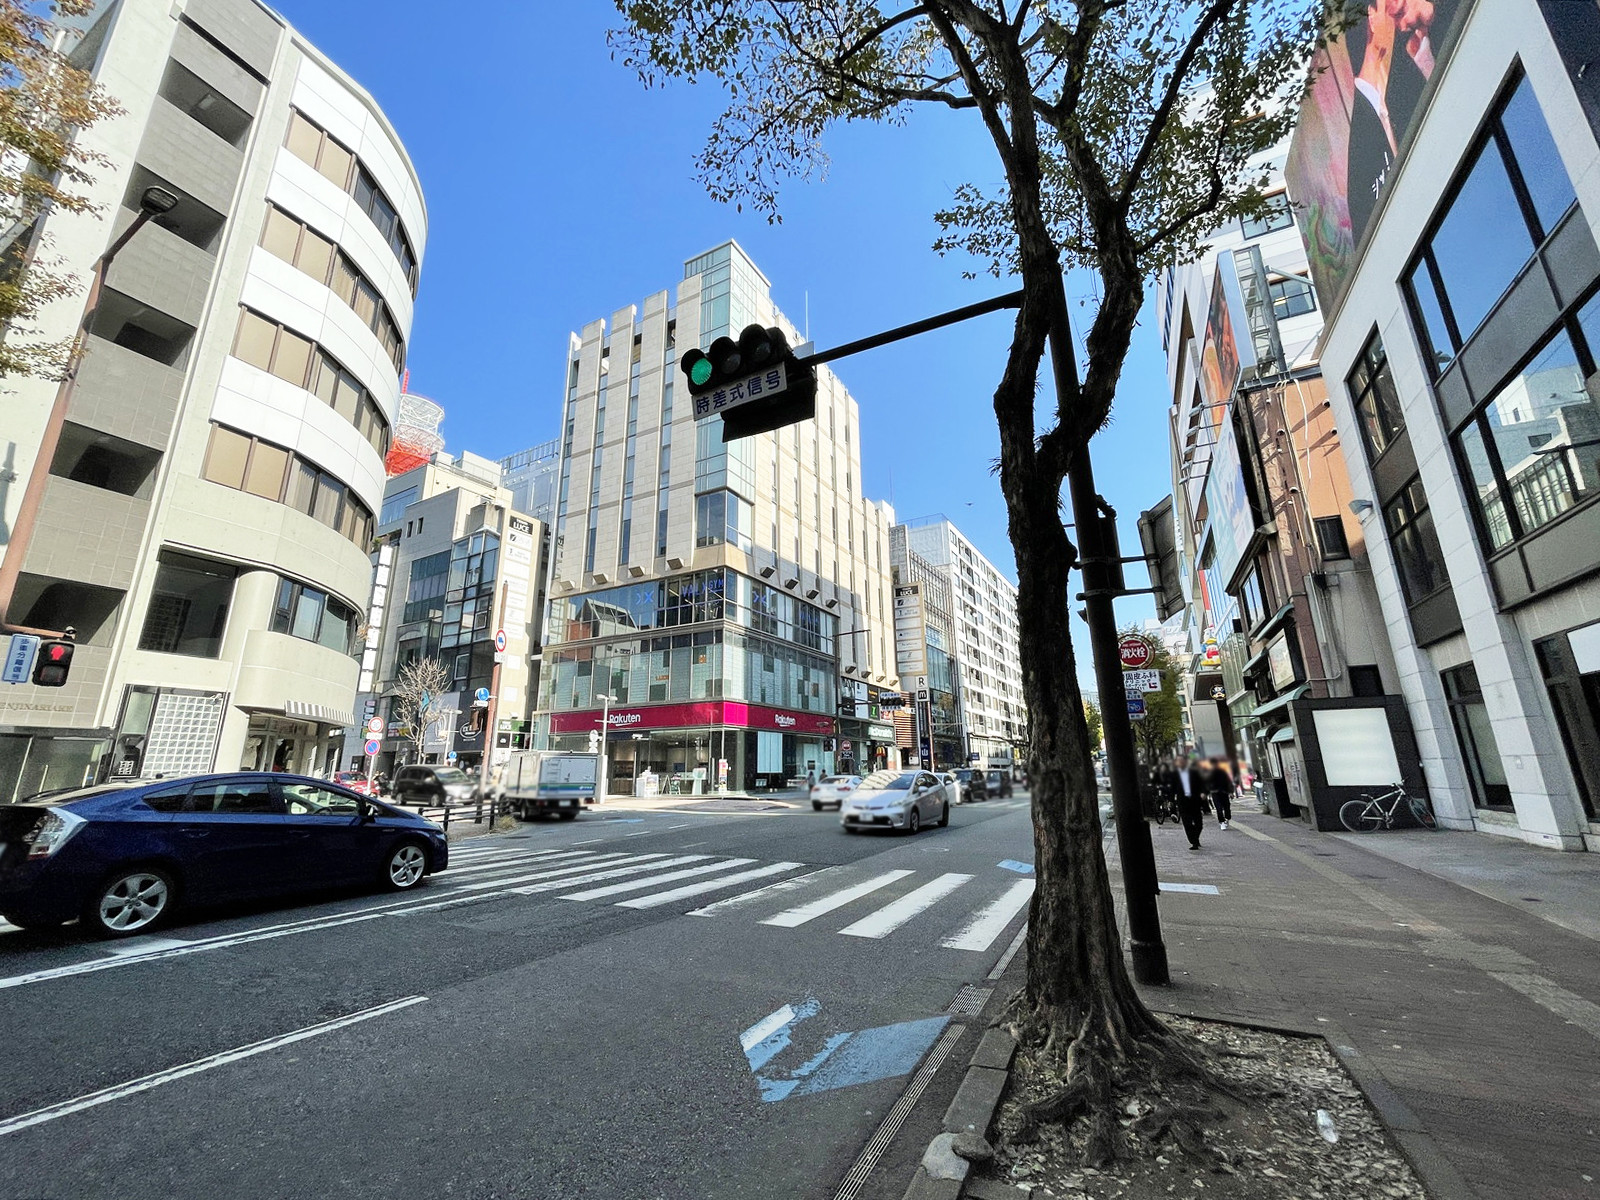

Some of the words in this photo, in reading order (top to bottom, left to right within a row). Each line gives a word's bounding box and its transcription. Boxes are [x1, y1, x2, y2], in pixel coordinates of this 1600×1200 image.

[696, 369, 782, 415] 時差式信号
[1121, 646, 1147, 659] 消火栓
[610, 713, 641, 724] Rakuten
[774, 714, 796, 726] Rakuten
